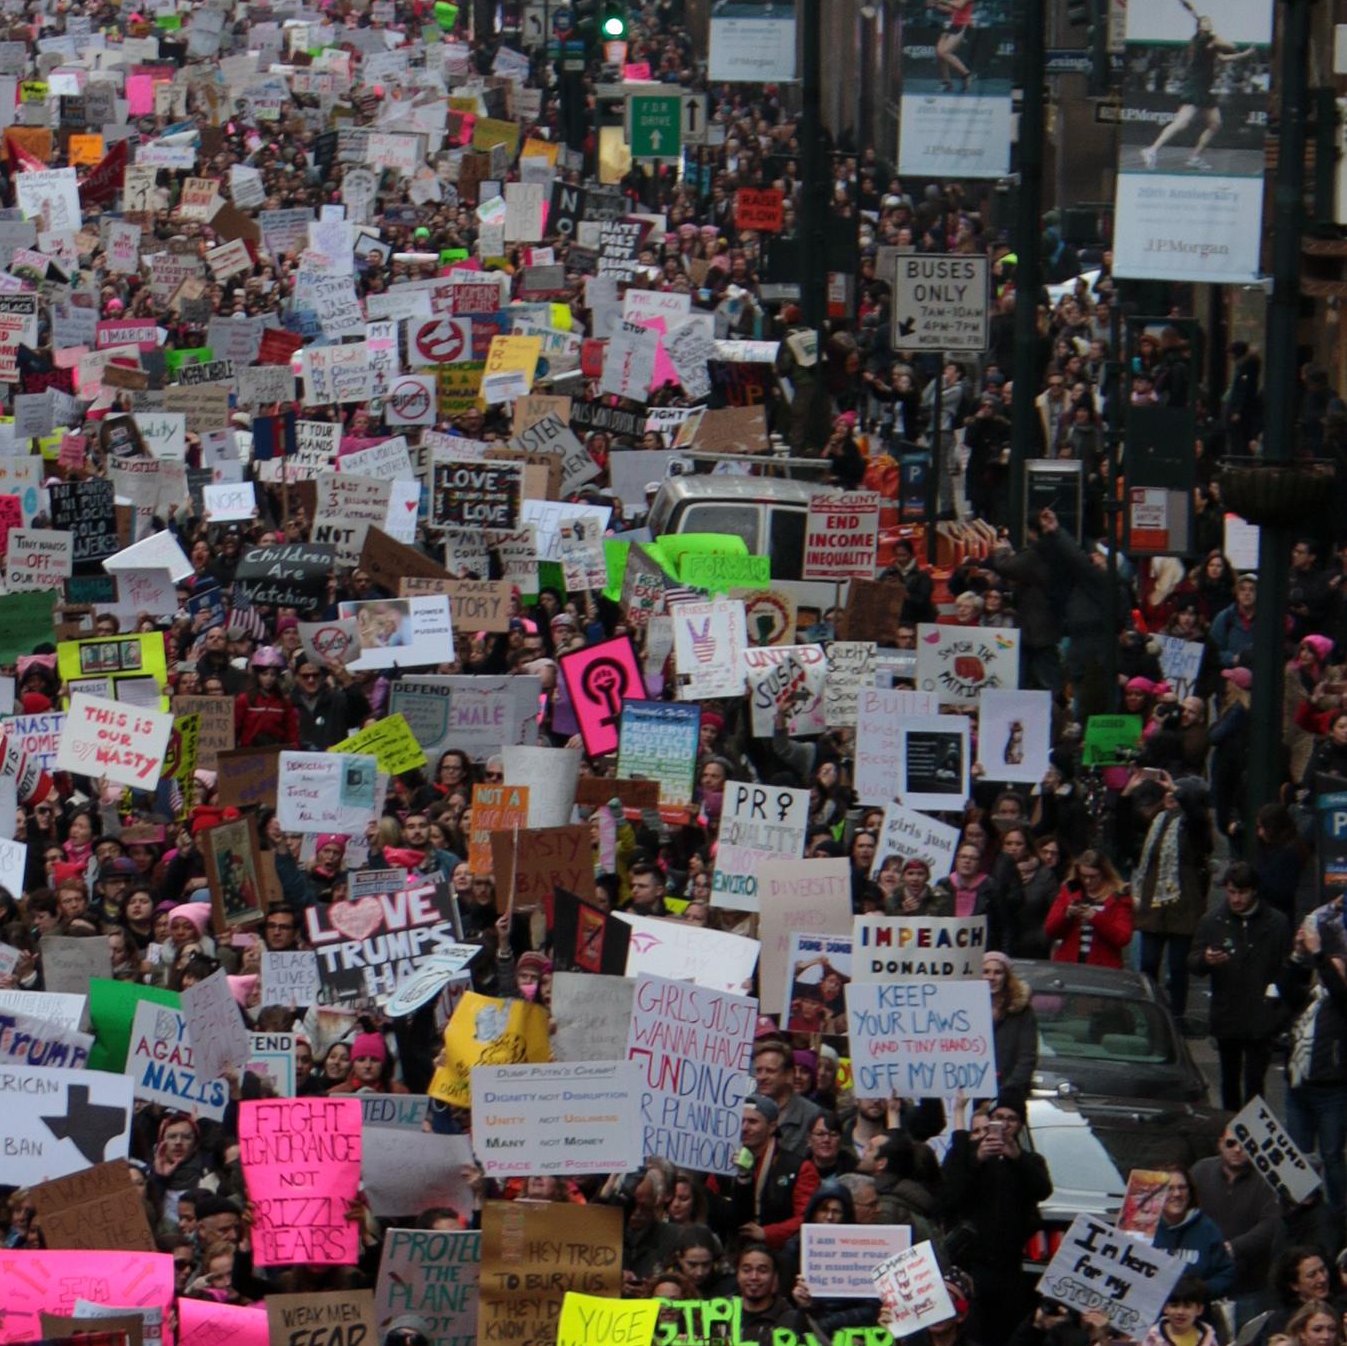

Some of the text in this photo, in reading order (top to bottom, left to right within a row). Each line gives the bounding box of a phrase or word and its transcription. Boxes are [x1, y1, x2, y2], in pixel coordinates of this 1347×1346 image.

[740, 194, 781, 209] RAISE
[740, 209, 780, 224] PLOW
[906, 260, 976, 280] BUSES
[914, 283, 968, 303] ONLY
[920, 305, 983, 318] 7AM-10AM
[922, 320, 980, 332] 4PM-7PM
[826, 515, 860, 529] END
[808, 533, 874, 548] INCOME
[245, 548, 331, 565] Children
[806, 551, 874, 566] INEQUALITY
[267, 566, 305, 581] Are
[457, 581, 499, 593] MAKE
[239, 584, 318, 610] Watching
[862, 926, 984, 949] IMPEACH
[871, 959, 954, 976] DONALD
[877, 984, 937, 1008] KEEP
[854, 1008, 971, 1036] YOUR LAWS
[868, 1036, 986, 1055] (AND TINY HANDS)
[859, 1061, 990, 1091] OFF MY BODY
[255, 1102, 345, 1134] FIGHT
[240, 1134, 361, 1166] IGNORANCE
[485, 1138, 527, 1149] MANY
[486, 1160, 531, 1171] PEACE
[280, 1171, 320, 1187] NOT
[262, 1230, 347, 1262] BEARS
[578, 1305, 647, 1344] YUGE
